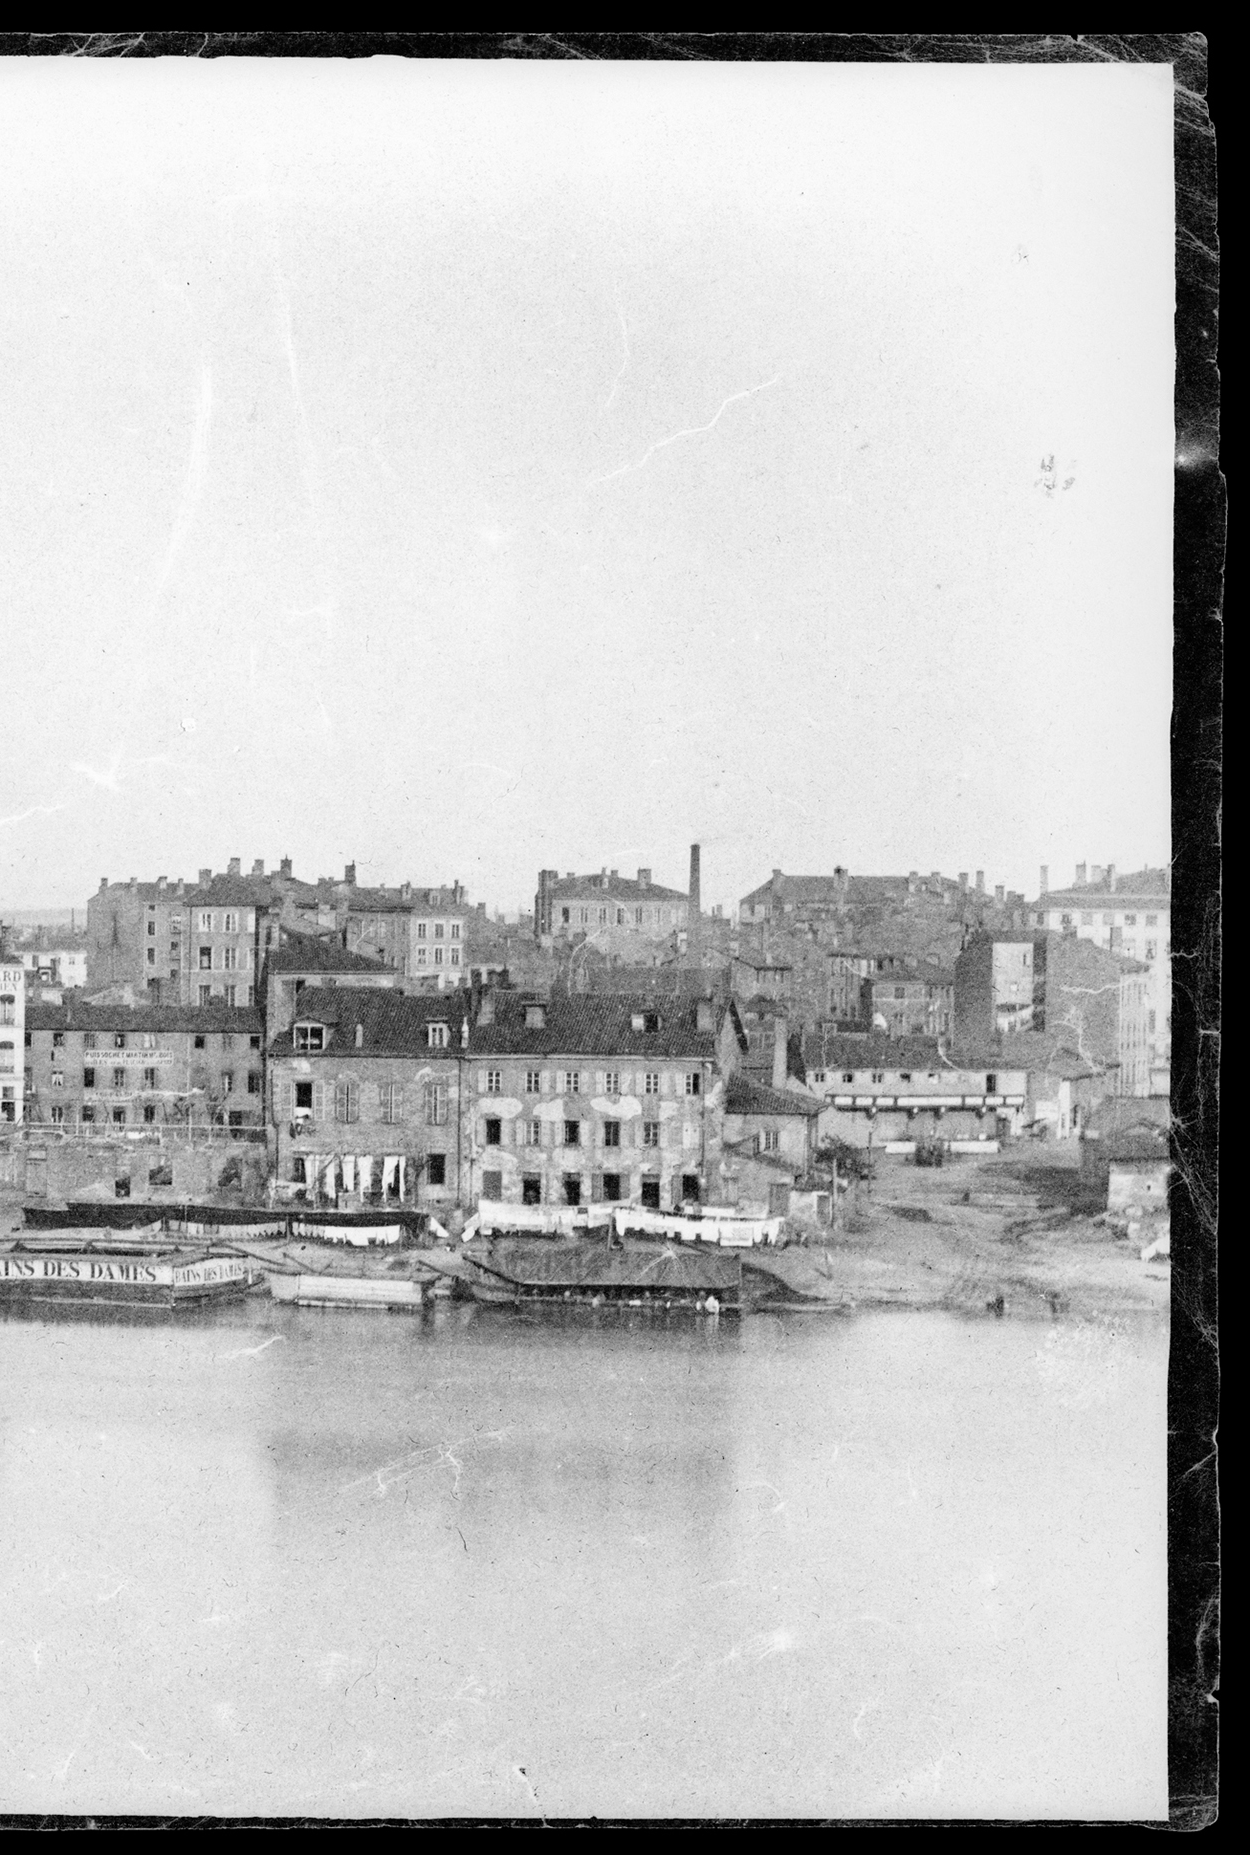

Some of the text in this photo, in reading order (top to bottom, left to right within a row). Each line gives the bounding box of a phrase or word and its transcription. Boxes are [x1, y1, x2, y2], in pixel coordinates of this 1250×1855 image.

[43, 1261, 81, 1279] DES
[90, 1262, 156, 1282] DAMES
[175, 1269, 201, 1283] BAINS
